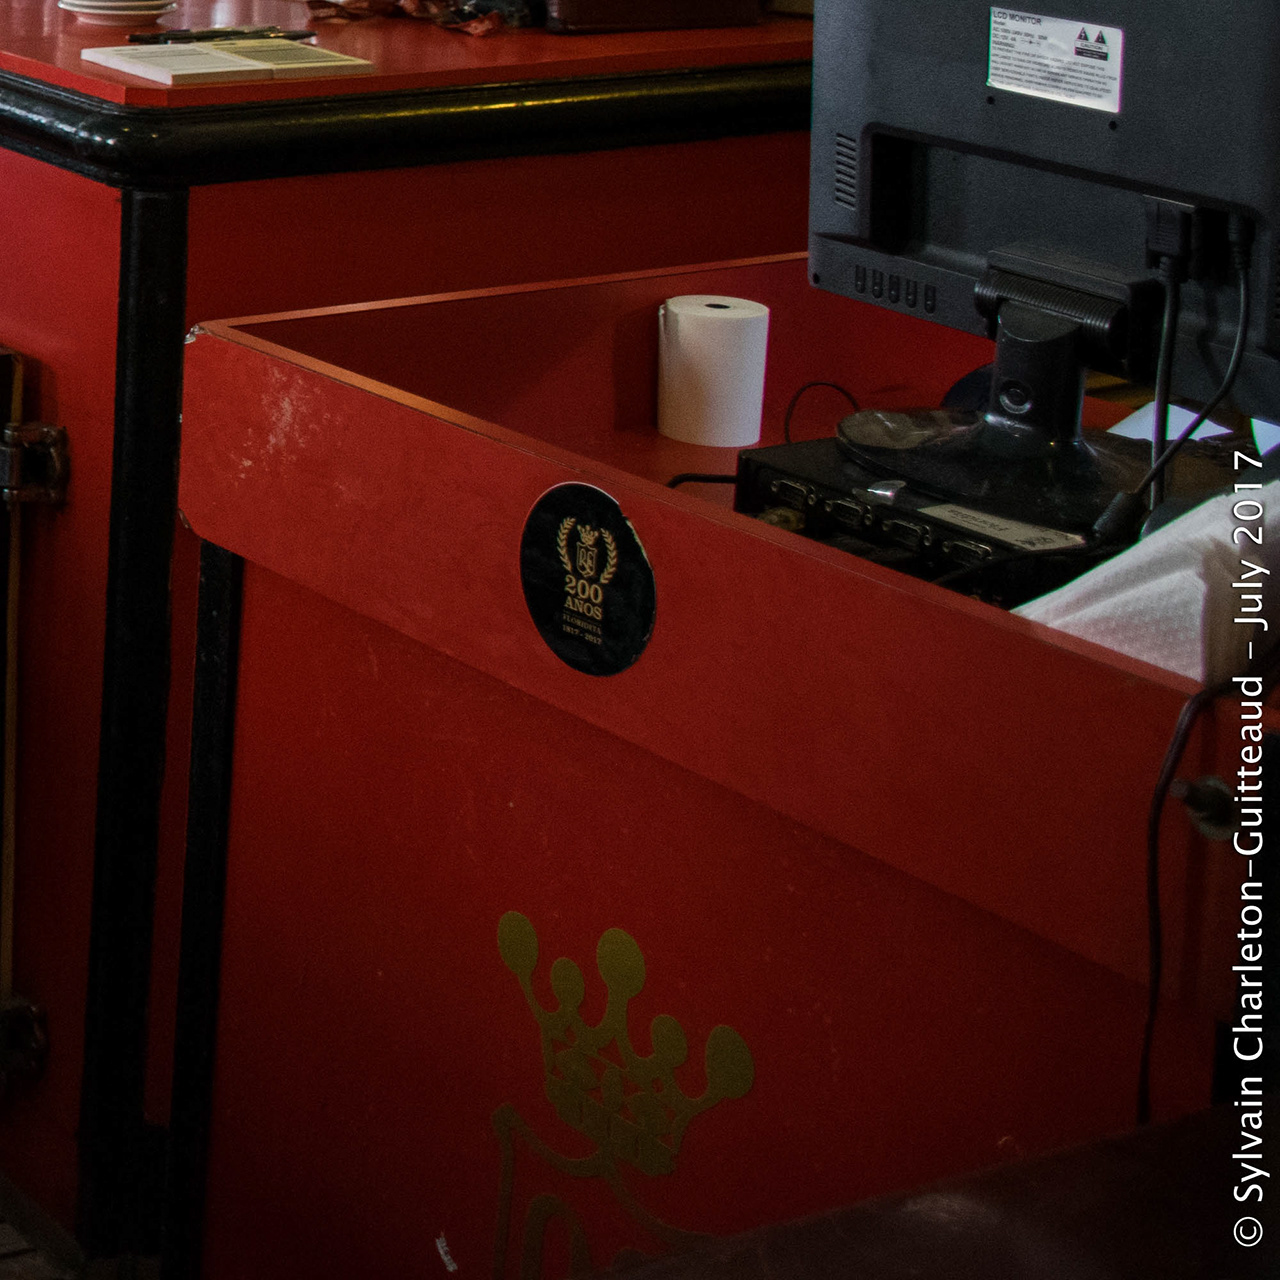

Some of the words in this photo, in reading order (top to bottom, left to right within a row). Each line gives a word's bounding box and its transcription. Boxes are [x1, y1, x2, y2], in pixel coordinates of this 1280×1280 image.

[993, 10, 1008, 20] LCD
[1009, 11, 1042, 26] MONITOR
[564, 574, 604, 605] 200
[563, 594, 602, 620] AÑOS
